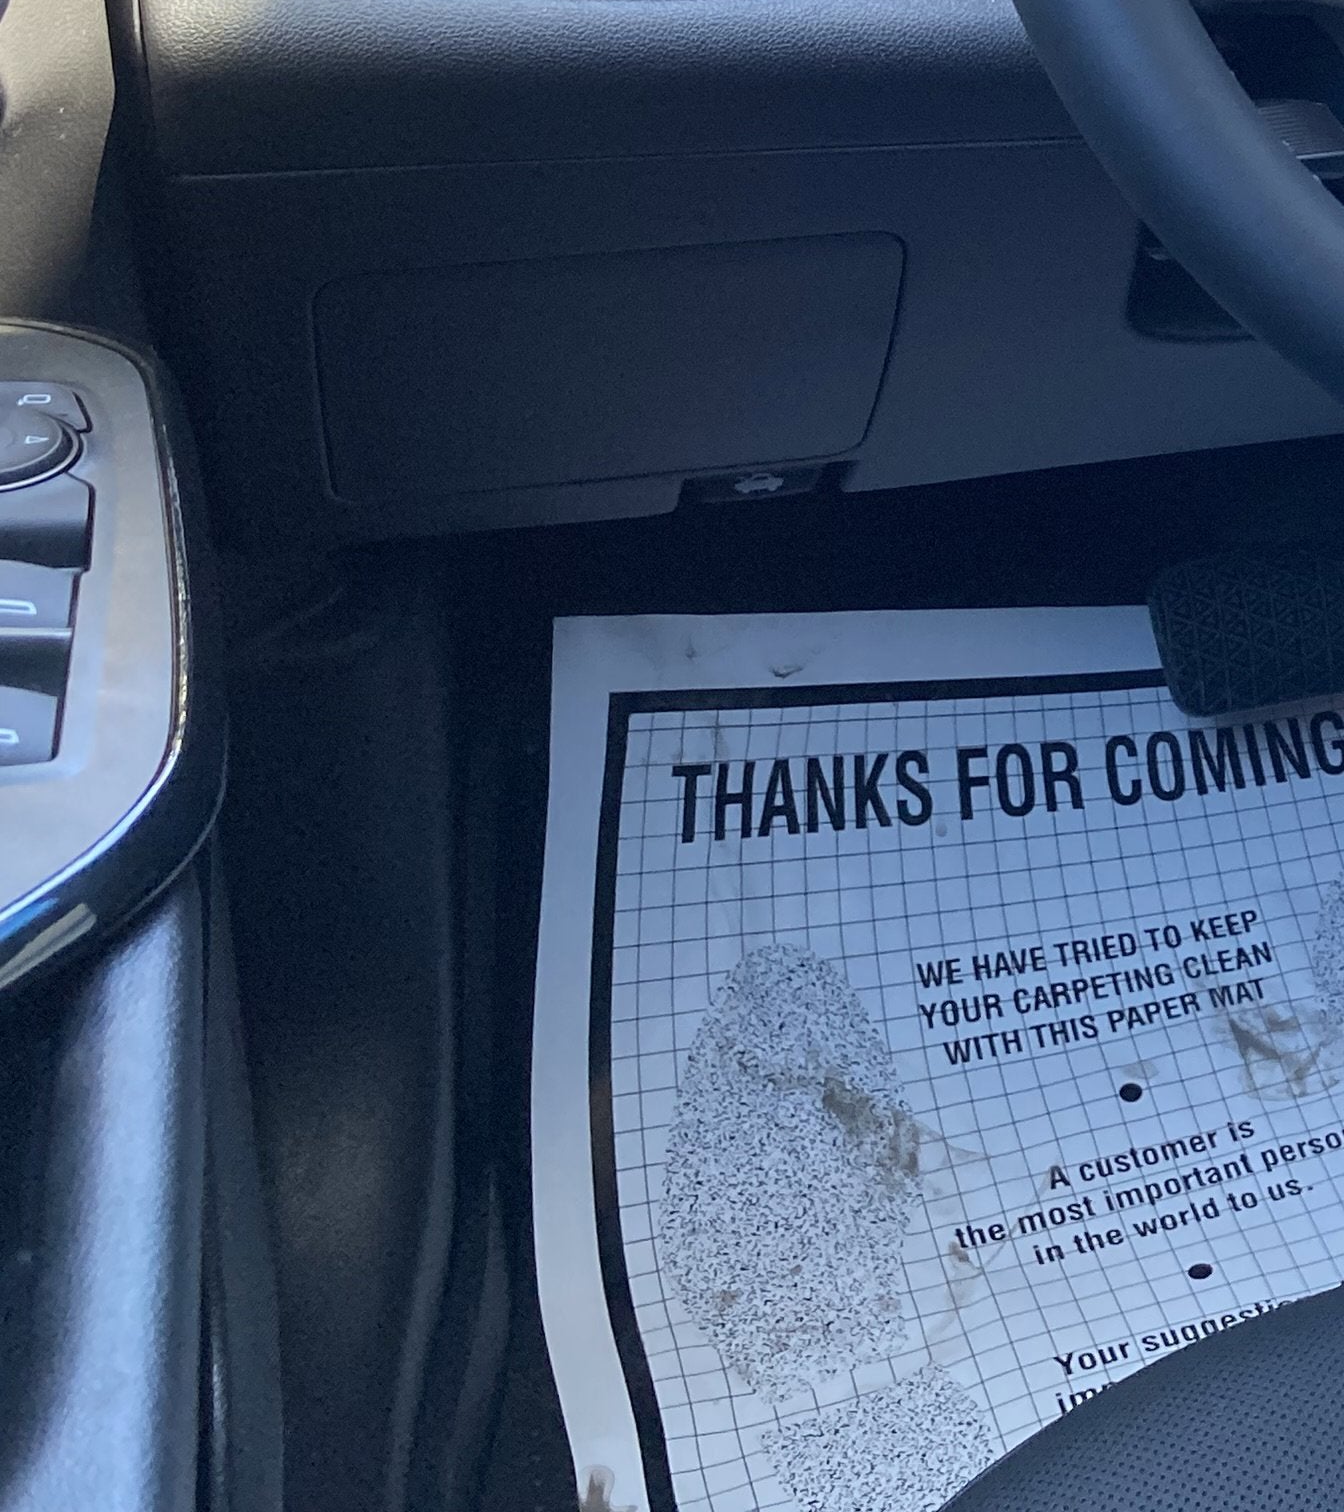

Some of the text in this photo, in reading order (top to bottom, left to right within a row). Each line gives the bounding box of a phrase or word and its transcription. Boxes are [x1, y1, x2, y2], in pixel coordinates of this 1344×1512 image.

[672, 750, 934, 844] THANKS
[957, 741, 1084, 820] FOR
[917, 910, 1258, 988] WE HAVE TRIED TO KEEP
[920, 941, 1274, 1029] YOUR CARPETING CLEAN
[943, 978, 1265, 1066] WITH THIS PAPER MAT
[1049, 1120, 1256, 1190] A customer is
[955, 1223, 1007, 1250] the
[1017, 1198, 1097, 1234] most
[1104, 1153, 1254, 1214] important
[1033, 1178, 1314, 1266] in the world to us.
[1053, 1341, 1130, 1376] Your
[1055, 1381, 1114, 1415] im
